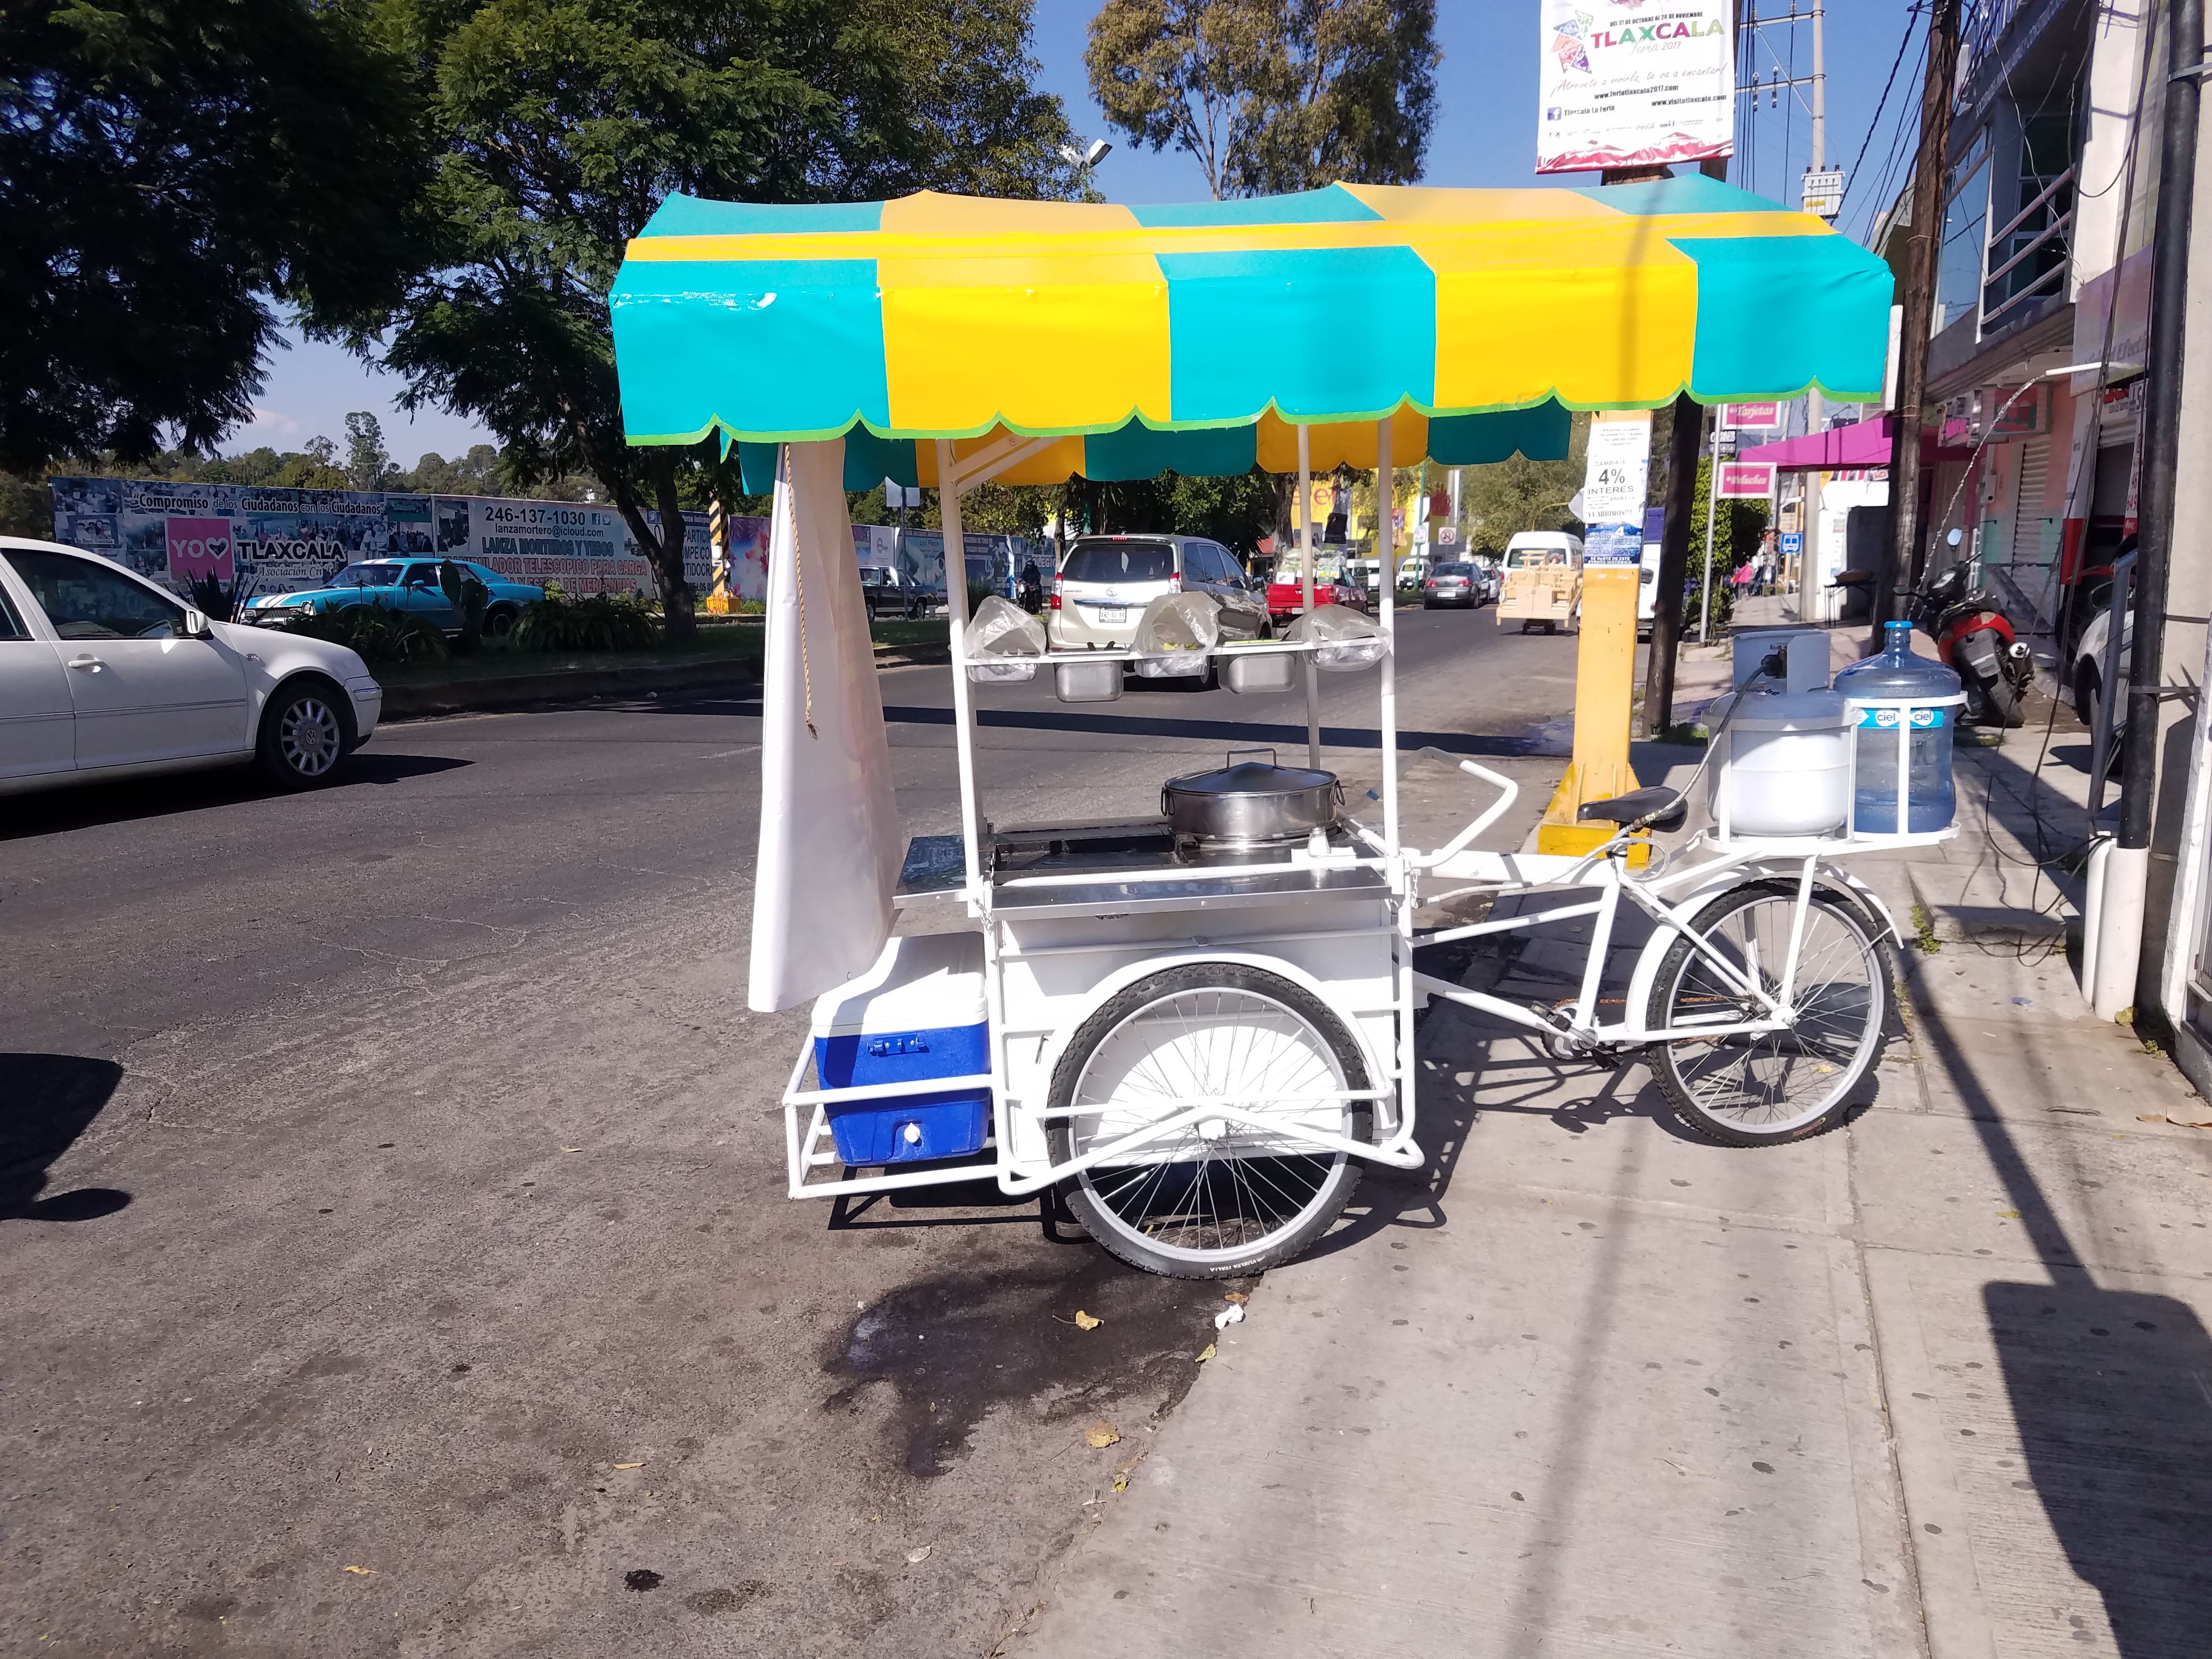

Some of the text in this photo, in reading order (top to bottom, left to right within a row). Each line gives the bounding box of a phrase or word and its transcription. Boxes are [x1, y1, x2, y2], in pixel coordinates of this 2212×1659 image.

[1632, 16, 1654, 24] OCTUBRE
[1590, 19, 1725, 49] TLAXCALA
[1628, 40, 1681, 55] Feria 2017
[1681, 61, 1728, 77] encantar!
[1564, 108, 1590, 116] Tlaxcala
[1737, 405, 1774, 419] Tarjetas
[1599, 468, 1625, 484] 4%
[1588, 486, 1634, 494] INTERES
[213, 500, 224, 508] de
[225, 499, 238, 509] los
[241, 498, 298, 512] Ciudadanos
[301, 504, 316, 512] con
[318, 504, 329, 512] los
[484, 506, 586, 525] 246-137-1030
[495, 523, 604, 538] lanzamortero@icloud.com
[171, 539, 205, 558] YO
[236, 541, 345, 560] TLAXCALA
[482, 537, 614, 557] LANZA MORTEROS Y YESOS
[258, 566, 307, 577] Asociación
[523, 557, 588, 575] TELESCOPICO
[591, 558, 616, 575] PARA
[617, 560, 647, 576] CARGA
[565, 577, 577, 593] DE
[579, 577, 637, 594] MERCANCIAS
[1877, 711, 1896, 721] ciel
[1914, 710, 1932, 721] ciel
[1233, 1259, 1257, 1269] VUELTA
